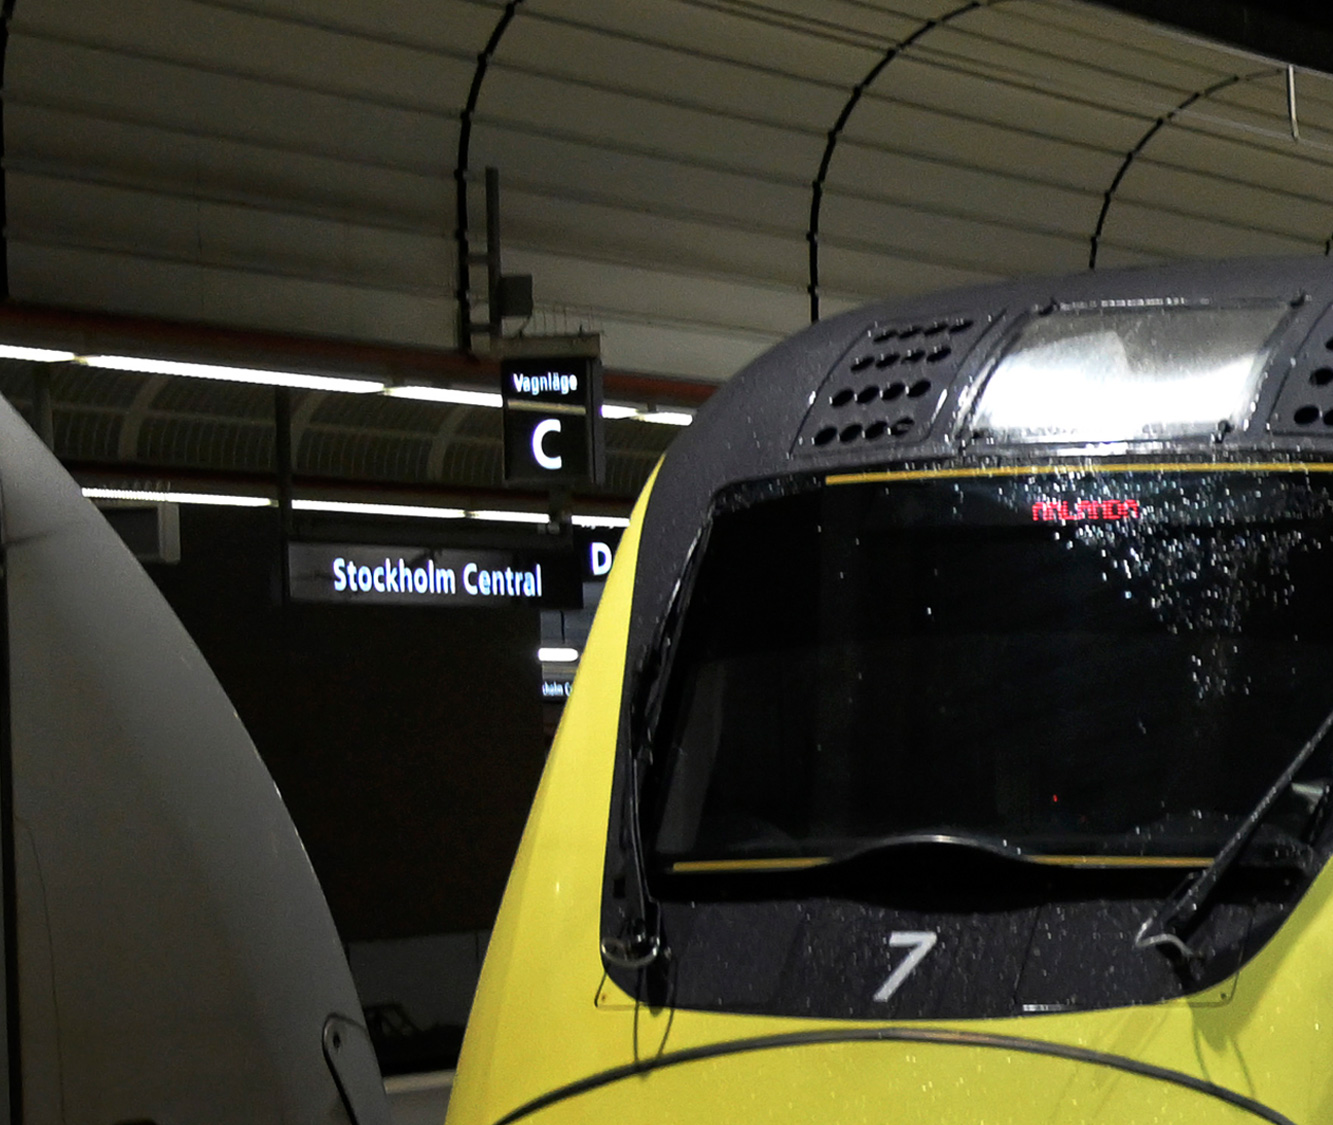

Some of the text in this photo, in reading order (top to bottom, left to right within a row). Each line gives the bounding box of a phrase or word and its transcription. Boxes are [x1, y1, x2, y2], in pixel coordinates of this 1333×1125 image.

[513, 371, 578, 396] Vagnläge
[531, 418, 563, 471] C
[333, 557, 543, 597] Stockholm Central
[590, 541, 612, 576] D
[873, 930, 938, 1003] 7
